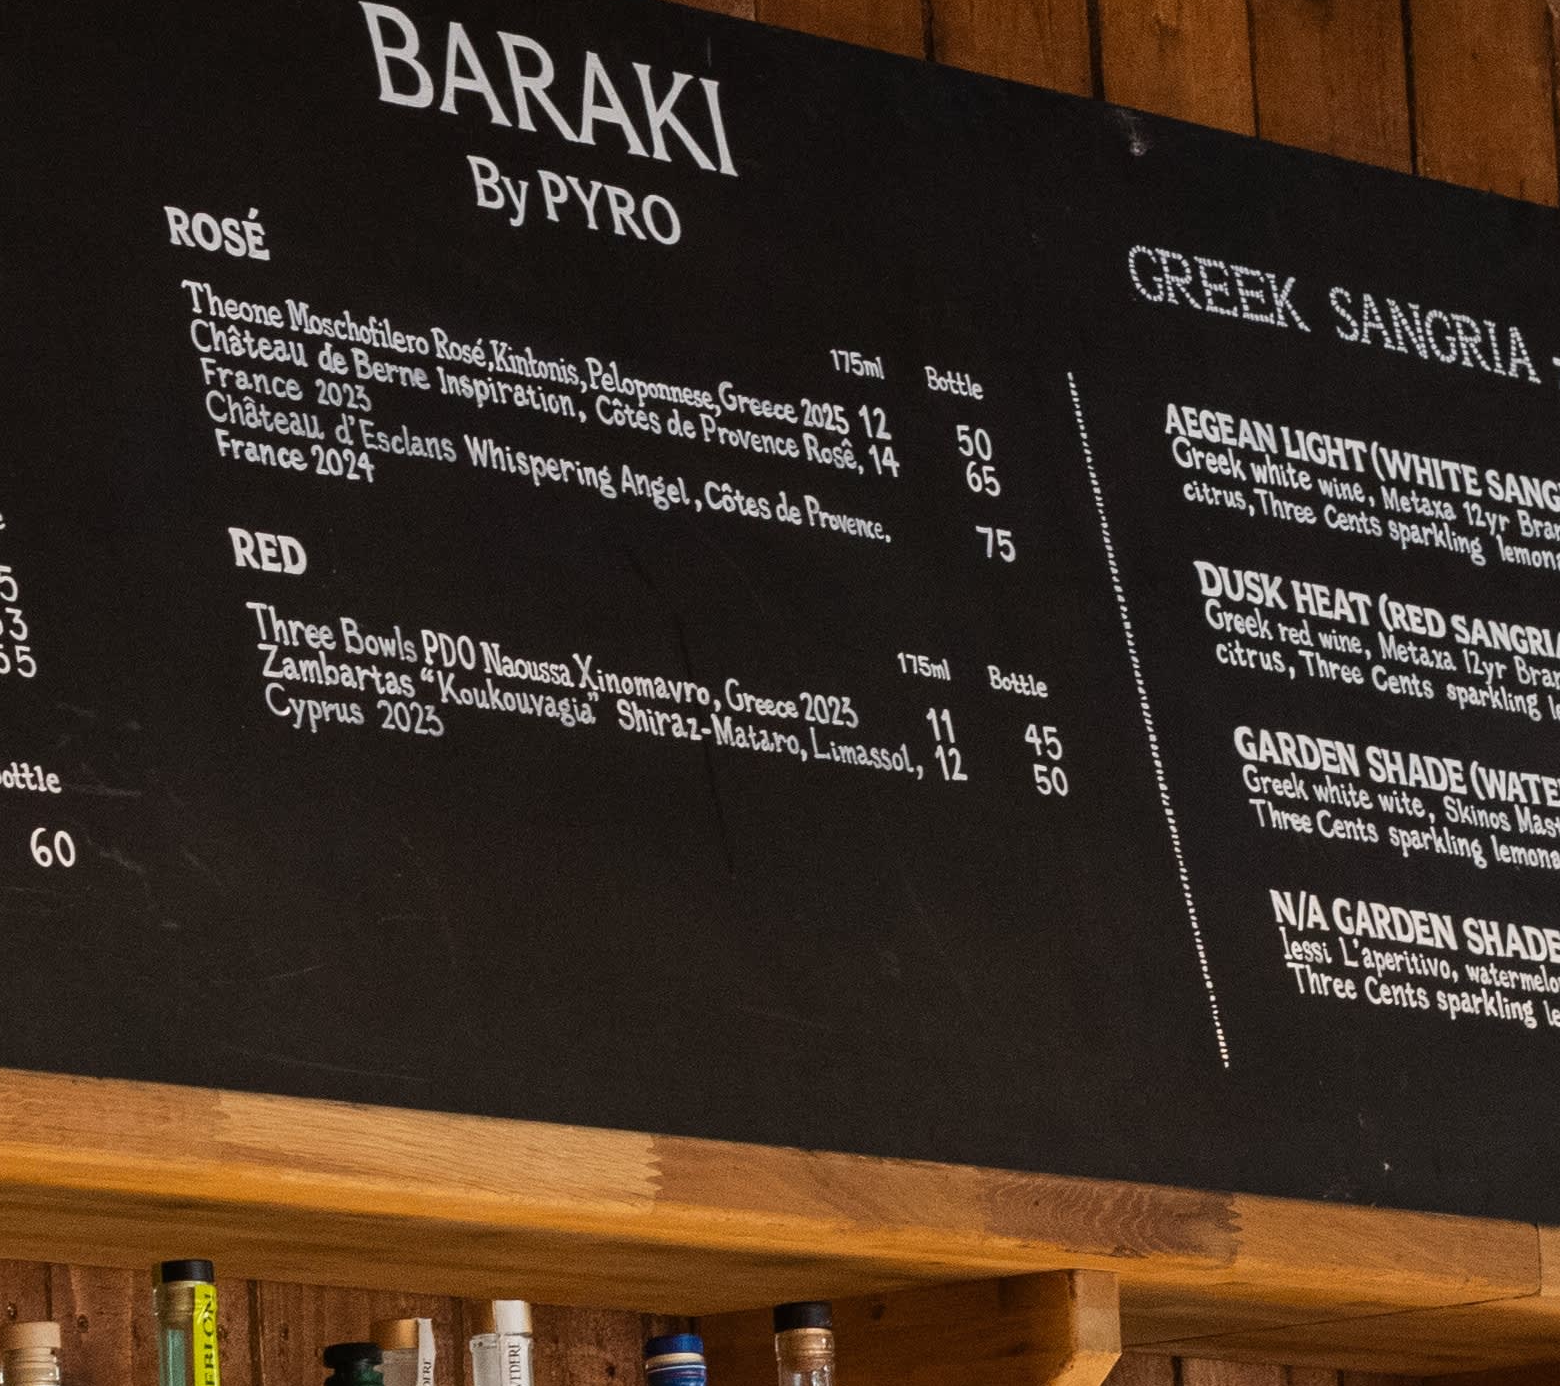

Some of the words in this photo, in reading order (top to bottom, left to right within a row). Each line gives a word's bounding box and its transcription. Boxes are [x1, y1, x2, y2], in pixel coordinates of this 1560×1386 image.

[359, 1, 738, 176] BARAKI
[467, 155, 528, 226] By
[538, 170, 681, 245] PYRO
[164, 206, 270, 260] ROSÉ
[1129, 245, 1311, 332] GREEK
[1329, 287, 1541, 384] SANGRIA
[191, 319, 308, 367] Château
[318, 342, 348, 375] de
[351, 348, 430, 389] Berne
[436, 366, 586, 423] Inspiration,
[957, 425, 992, 461] 50
[1165, 403, 1278, 454] AEGEAN
[1280, 426, 1367, 472] LIGHT
[1371, 441, 1482, 497] (WHITE
[1172, 436, 1246, 481] Greek
[1250, 454, 1312, 490] white
[966, 461, 1000, 496] 65
[228, 527, 307, 574] RED
[976, 526, 1016, 562] 75
[1193, 561, 1288, 609] DUSK
[1291, 580, 1372, 625] HEAT
[1379, 593, 1446, 638] (RED
[246, 602, 336, 650] Three
[340, 617, 417, 662] Bowls
[421, 630, 475, 670] PDO
[480, 642, 575, 687] Naoussa
[266, 683, 364, 733] Cyprus
[1216, 640, 1295, 679] citrus,
[1298, 650, 1364, 684] Three
[1372, 665, 1434, 699] Cents
[1447, 681, 1543, 722] sparkling
[926, 708, 955, 743] 11
[1025, 724, 1062, 760] 45
[1034, 764, 1068, 796] 50
[1234, 726, 1360, 777] GARDEN
[1366, 746, 1467, 794] SHADE
[1243, 764, 1309, 800] Greek
[1313, 775, 1373, 809] white
[1443, 795, 1511, 831] Skinos
[31, 828, 75, 867] 60
[1270, 889, 1330, 931] N/A
[1332, 898, 1458, 950] GARDEN
[1286, 962, 1357, 999] Three
[1365, 976, 1430, 1009] Cents
[1437, 988, 1537, 1029] sparkling
